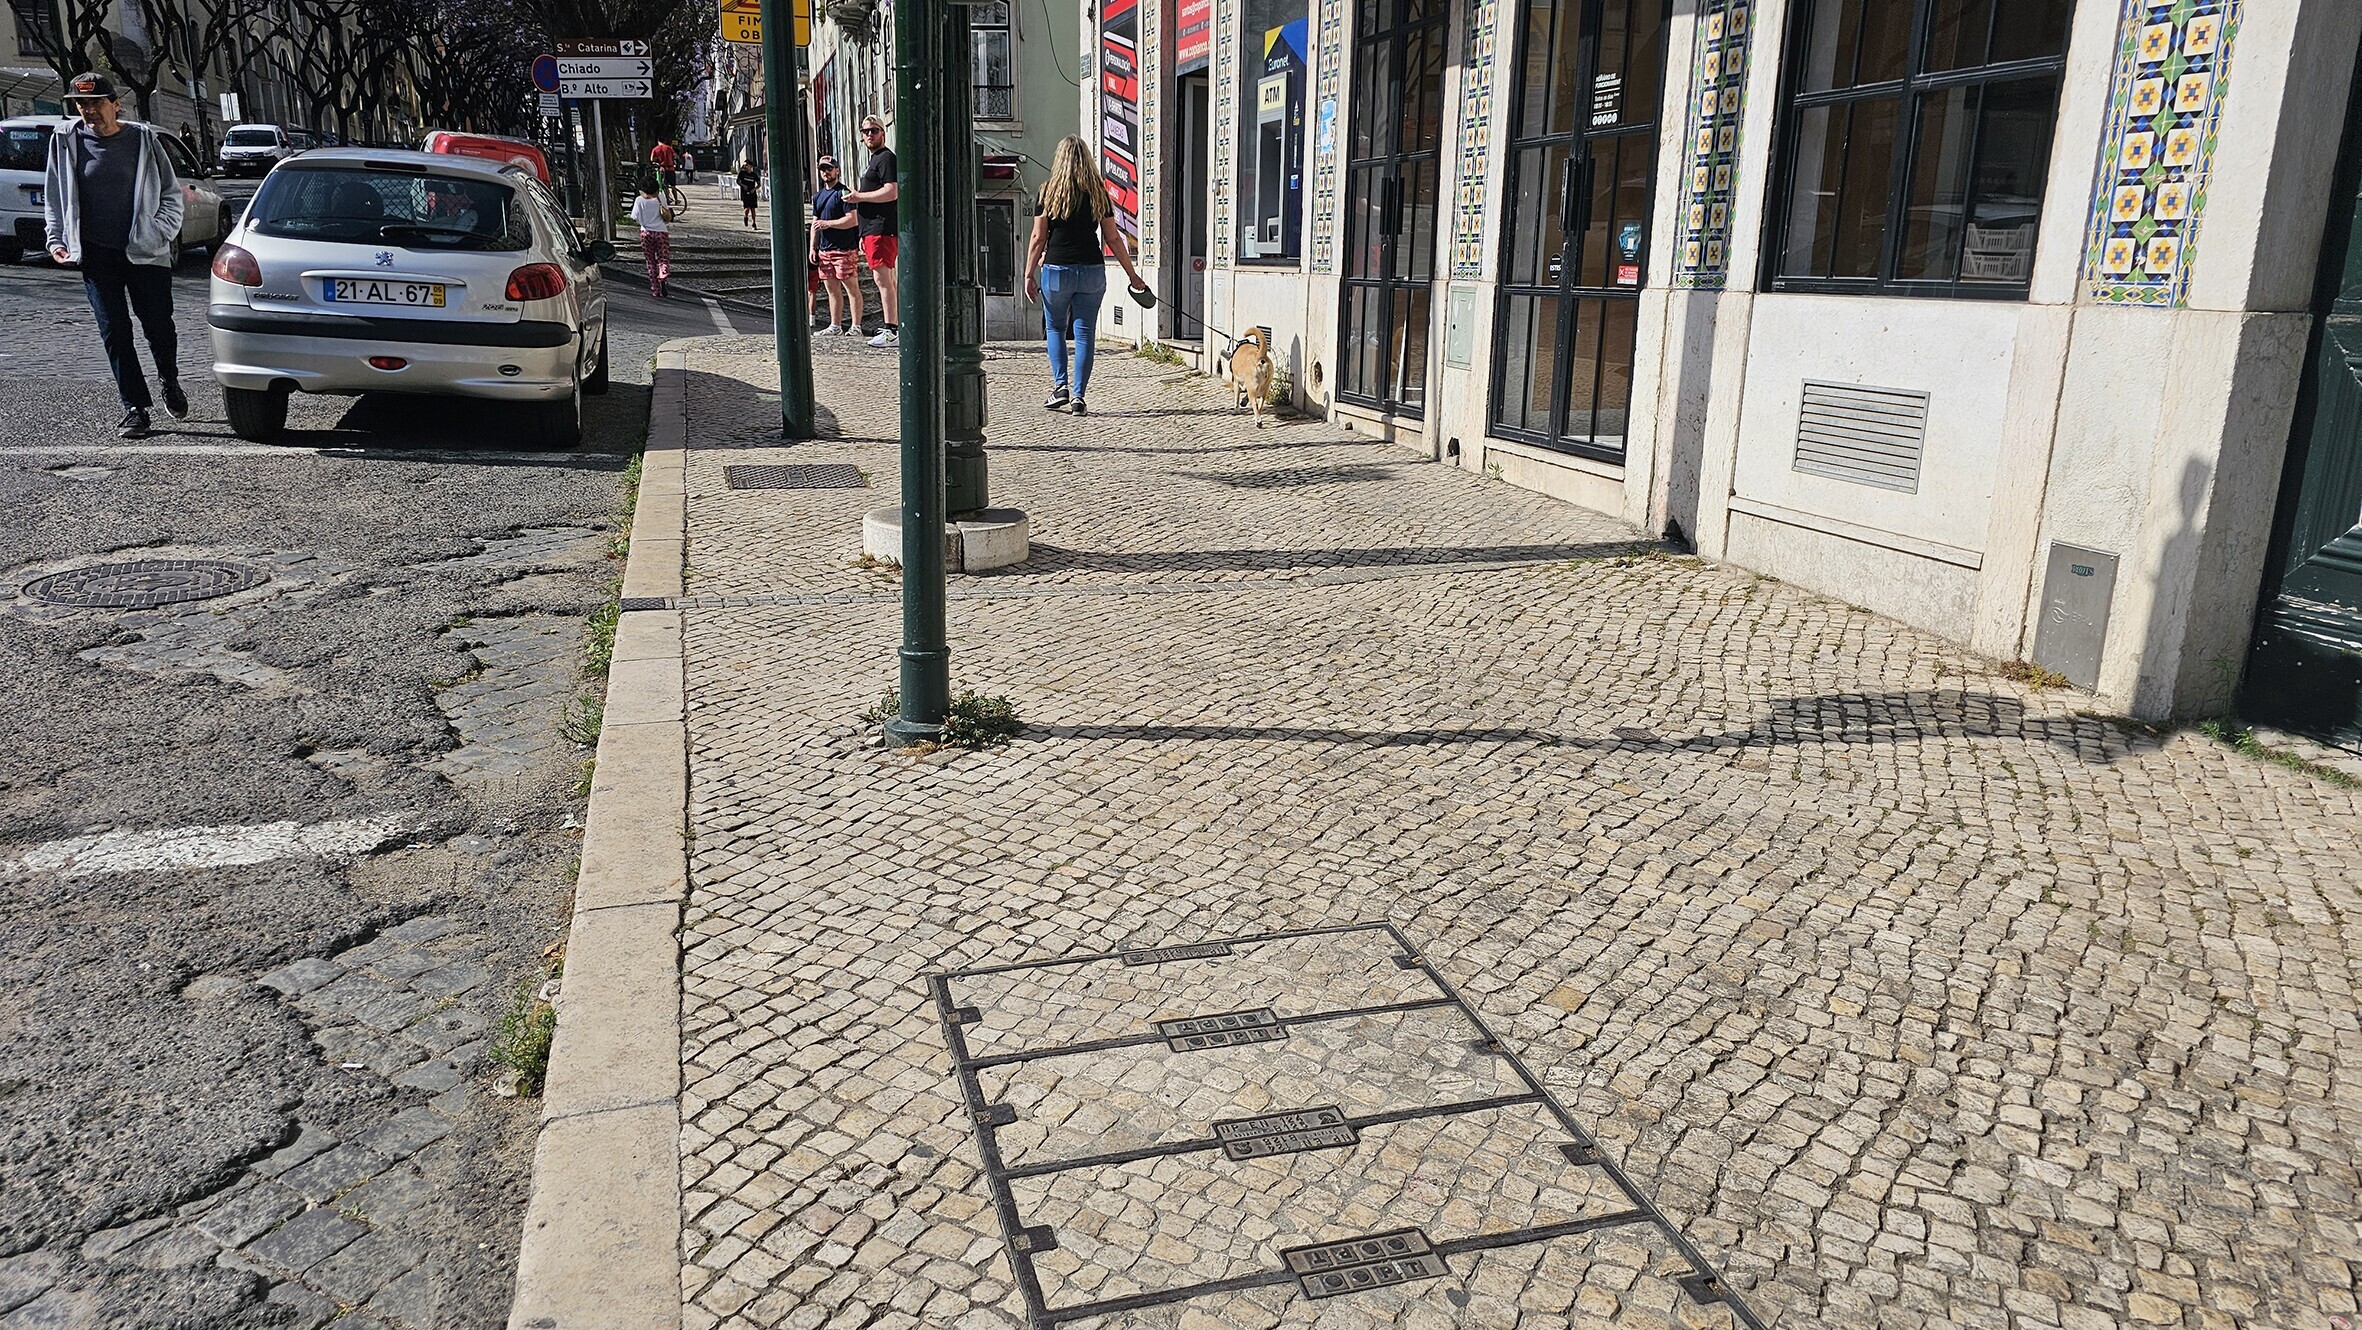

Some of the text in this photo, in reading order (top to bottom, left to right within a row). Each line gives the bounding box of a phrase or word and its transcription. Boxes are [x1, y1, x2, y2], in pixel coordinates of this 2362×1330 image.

[577, 42, 618, 53] Catarina
[558, 63, 601, 74] Chiado
[1268, 54, 1290, 71] Euronet
[584, 83, 609, 94] Alto
[1264, 85, 1281, 105] ATM
[1220, 1124, 1239, 1134] NP
[1249, 1119, 1269, 1129] EN
